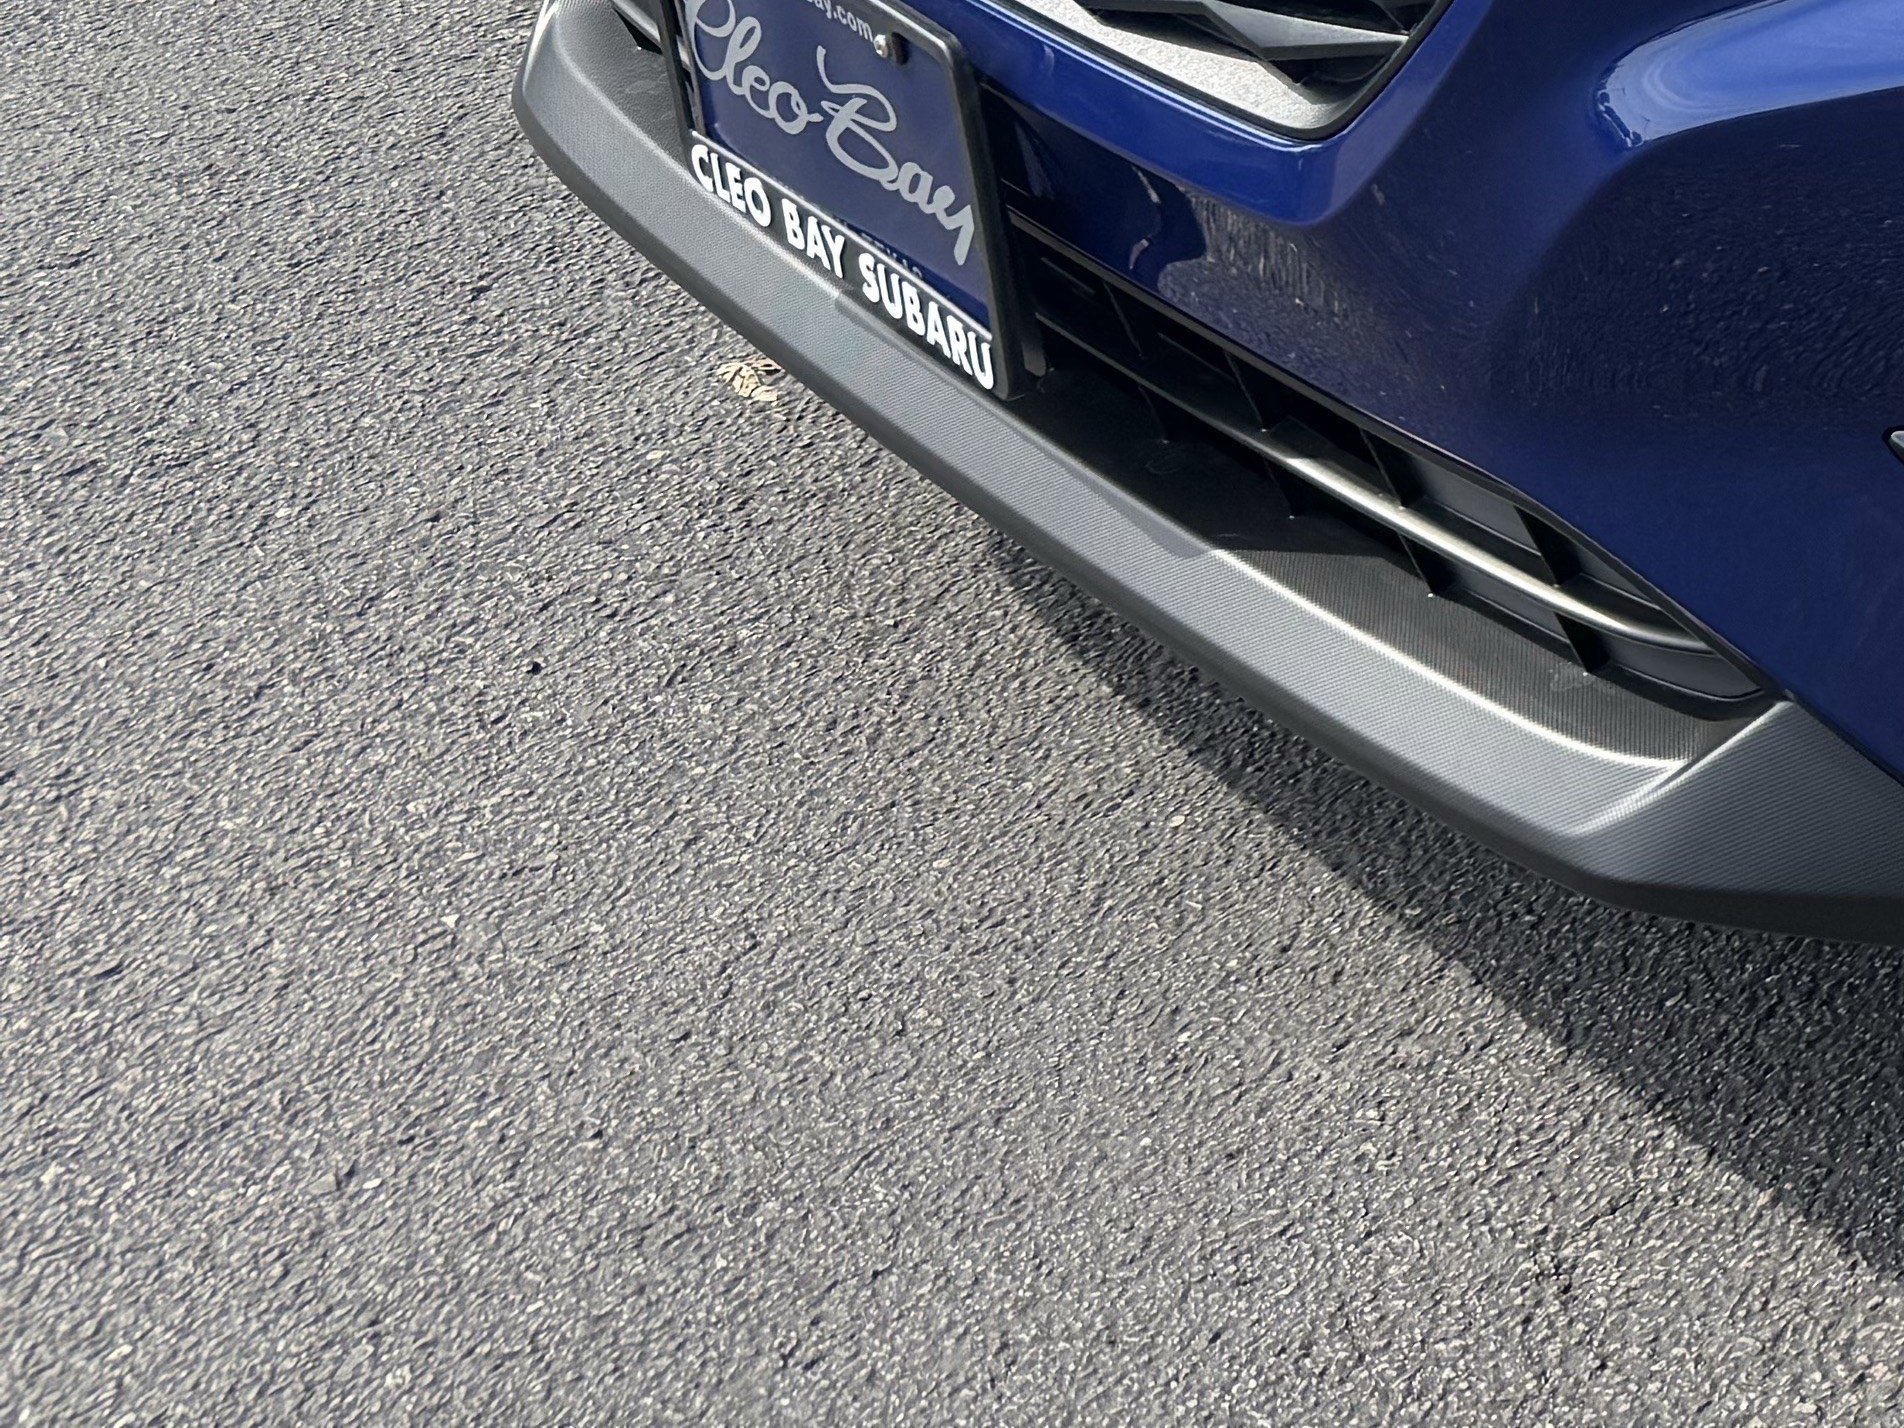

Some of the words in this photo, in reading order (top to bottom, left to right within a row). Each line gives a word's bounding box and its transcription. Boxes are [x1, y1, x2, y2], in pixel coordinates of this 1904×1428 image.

[691, 144, 772, 227] CLEO
[781, 199, 845, 278] BAY
[859, 253, 995, 390] SUBARU
[817, 45, 975, 266] Bay
